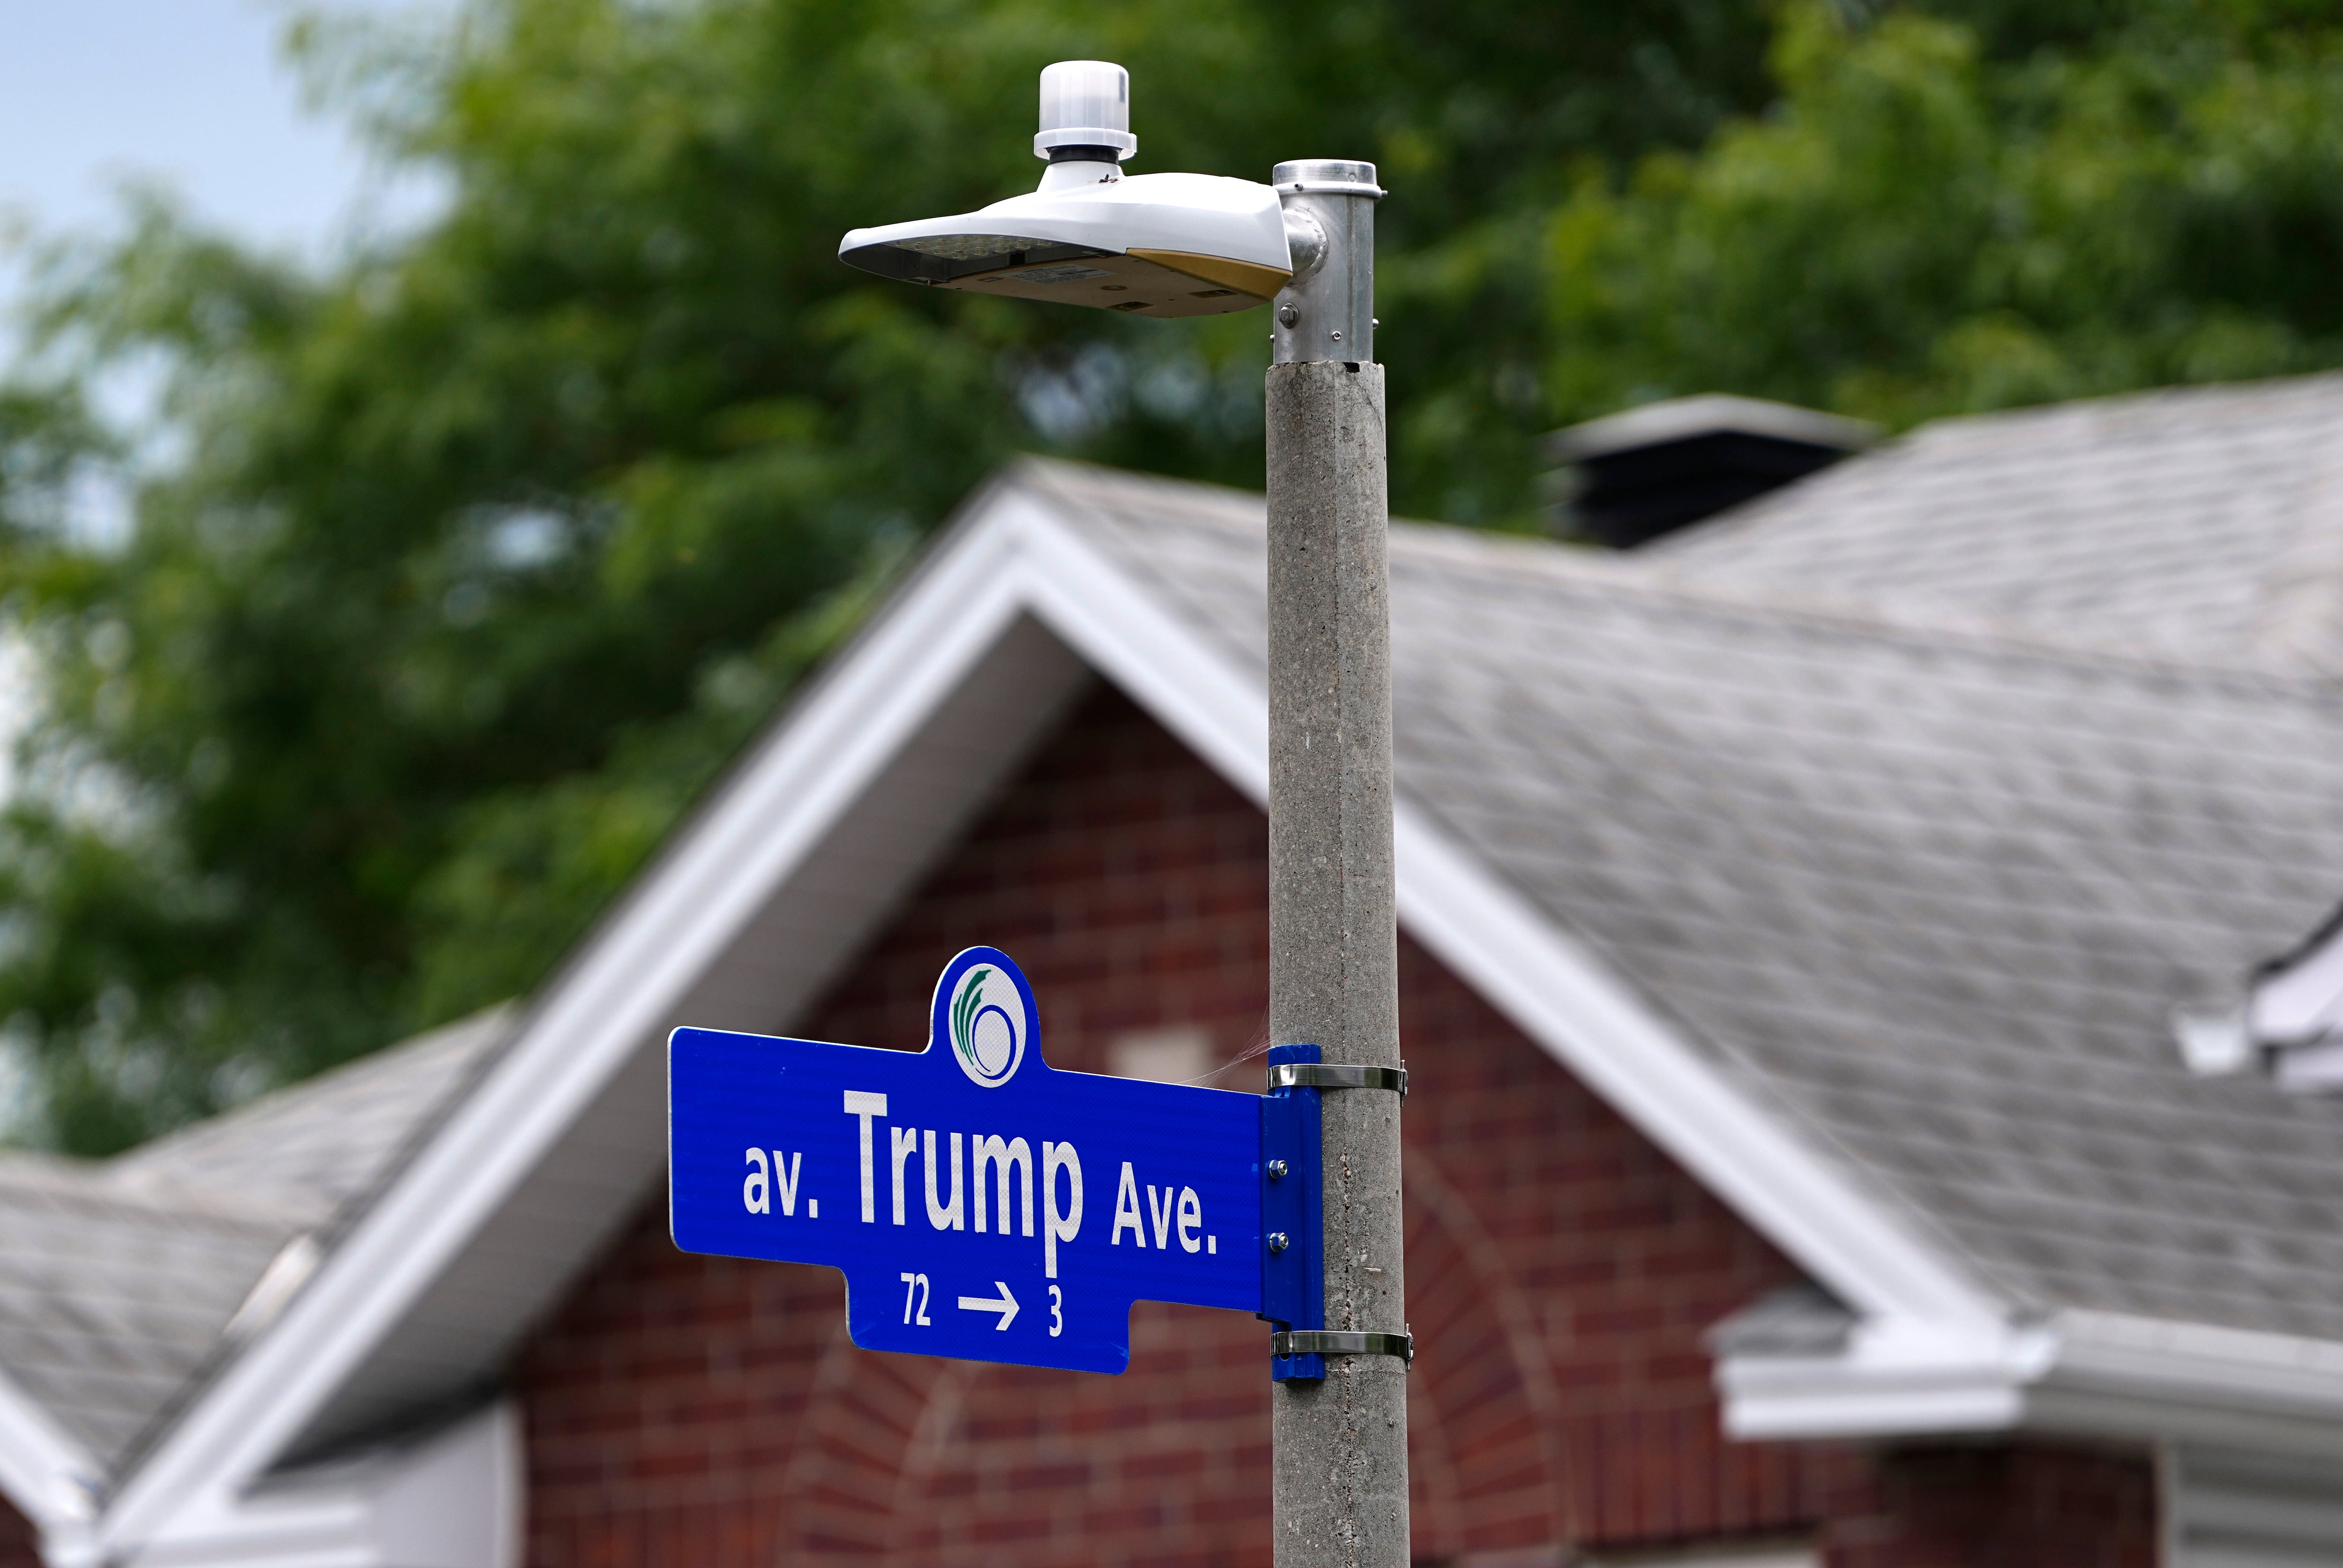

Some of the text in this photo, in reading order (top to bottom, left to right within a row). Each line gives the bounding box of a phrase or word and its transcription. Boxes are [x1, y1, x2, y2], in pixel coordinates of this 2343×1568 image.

[743, 1090, 1216, 1278] av. Trump Ave.
[901, 1272, 1062, 1337] 72 3
